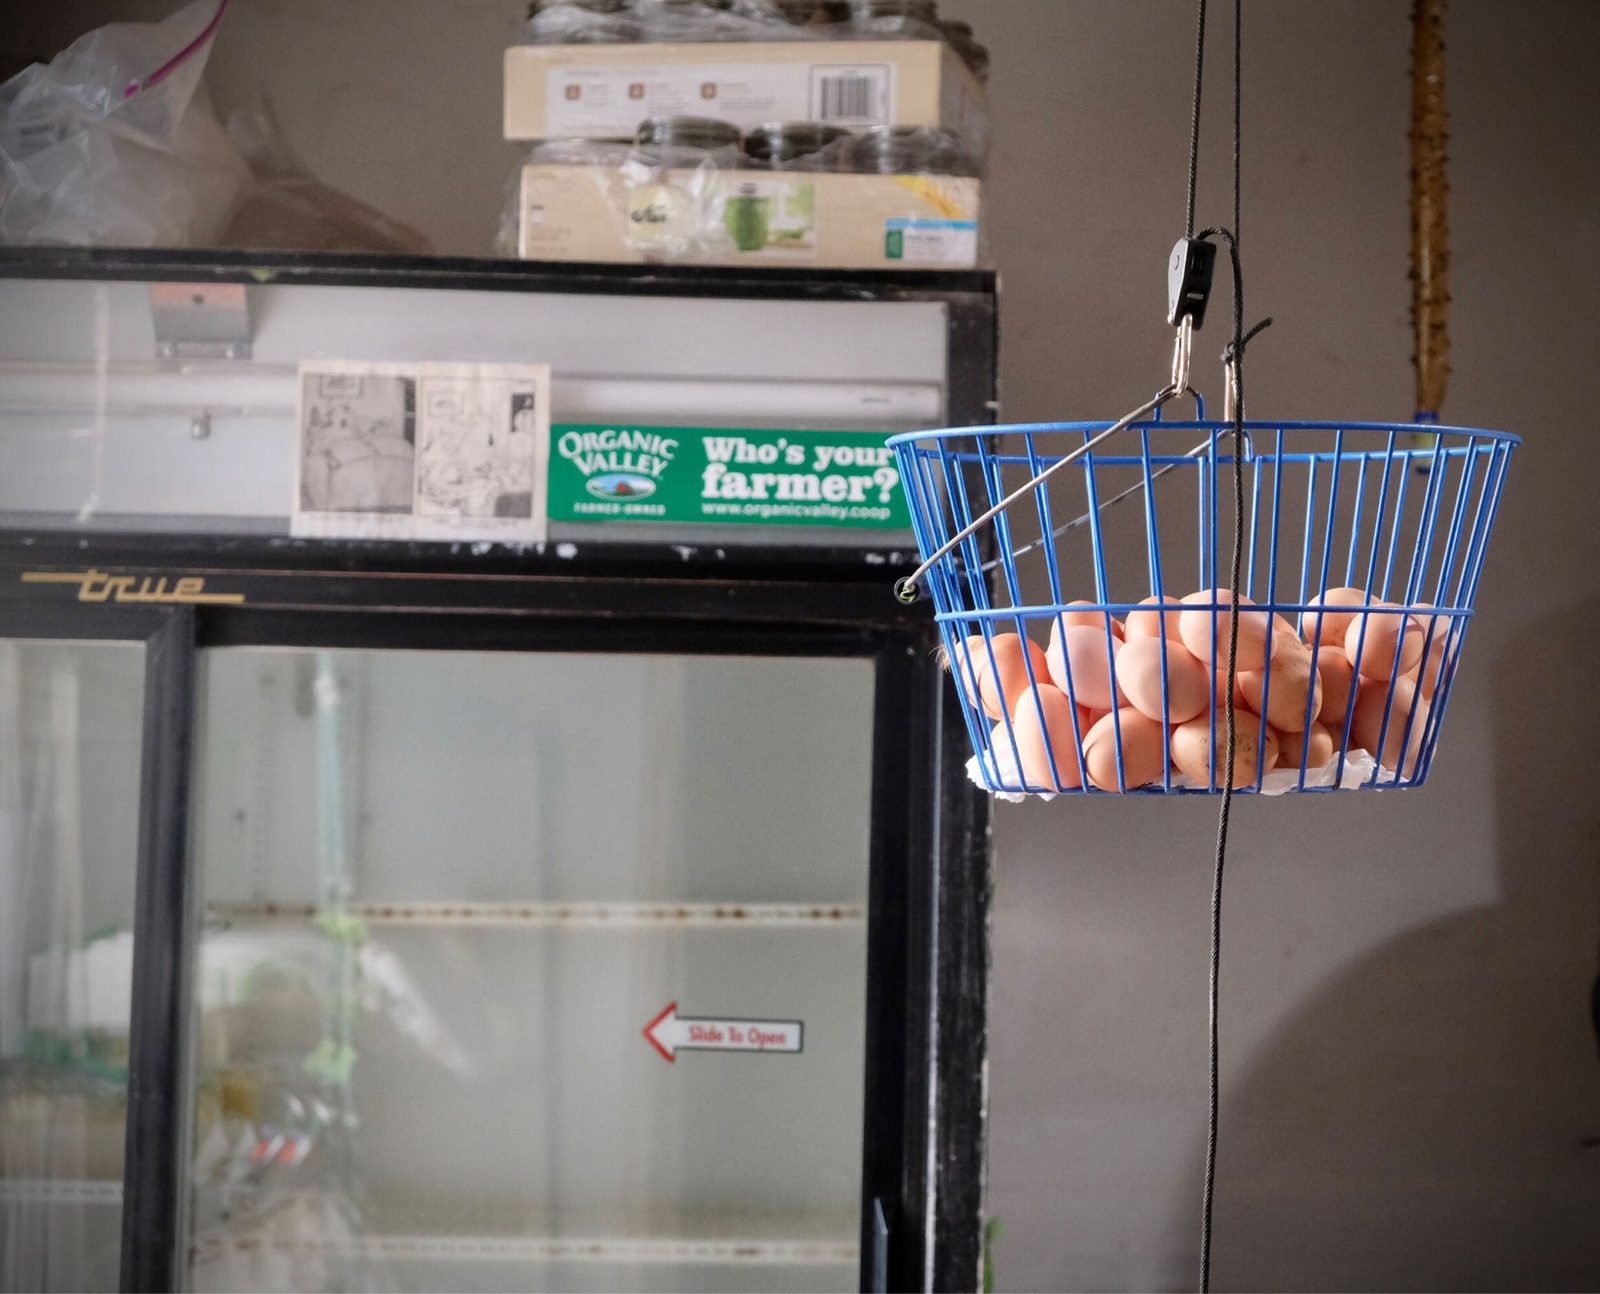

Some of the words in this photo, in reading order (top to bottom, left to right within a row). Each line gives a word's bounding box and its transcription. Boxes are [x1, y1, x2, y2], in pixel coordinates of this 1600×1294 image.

[558, 430, 680, 460] ORGANIC
[702, 436, 806, 465] Who's
[813, 445, 895, 472] your
[573, 450, 669, 477] VALLEY
[701, 463, 899, 503] farmer?
[701, 502, 890, 521] www.organicvalley.coop
[77, 568, 206, 602] true
[689, 1025, 723, 1042] Slide
[728, 1027, 744, 1044] To
[748, 1027, 786, 1048] Open
